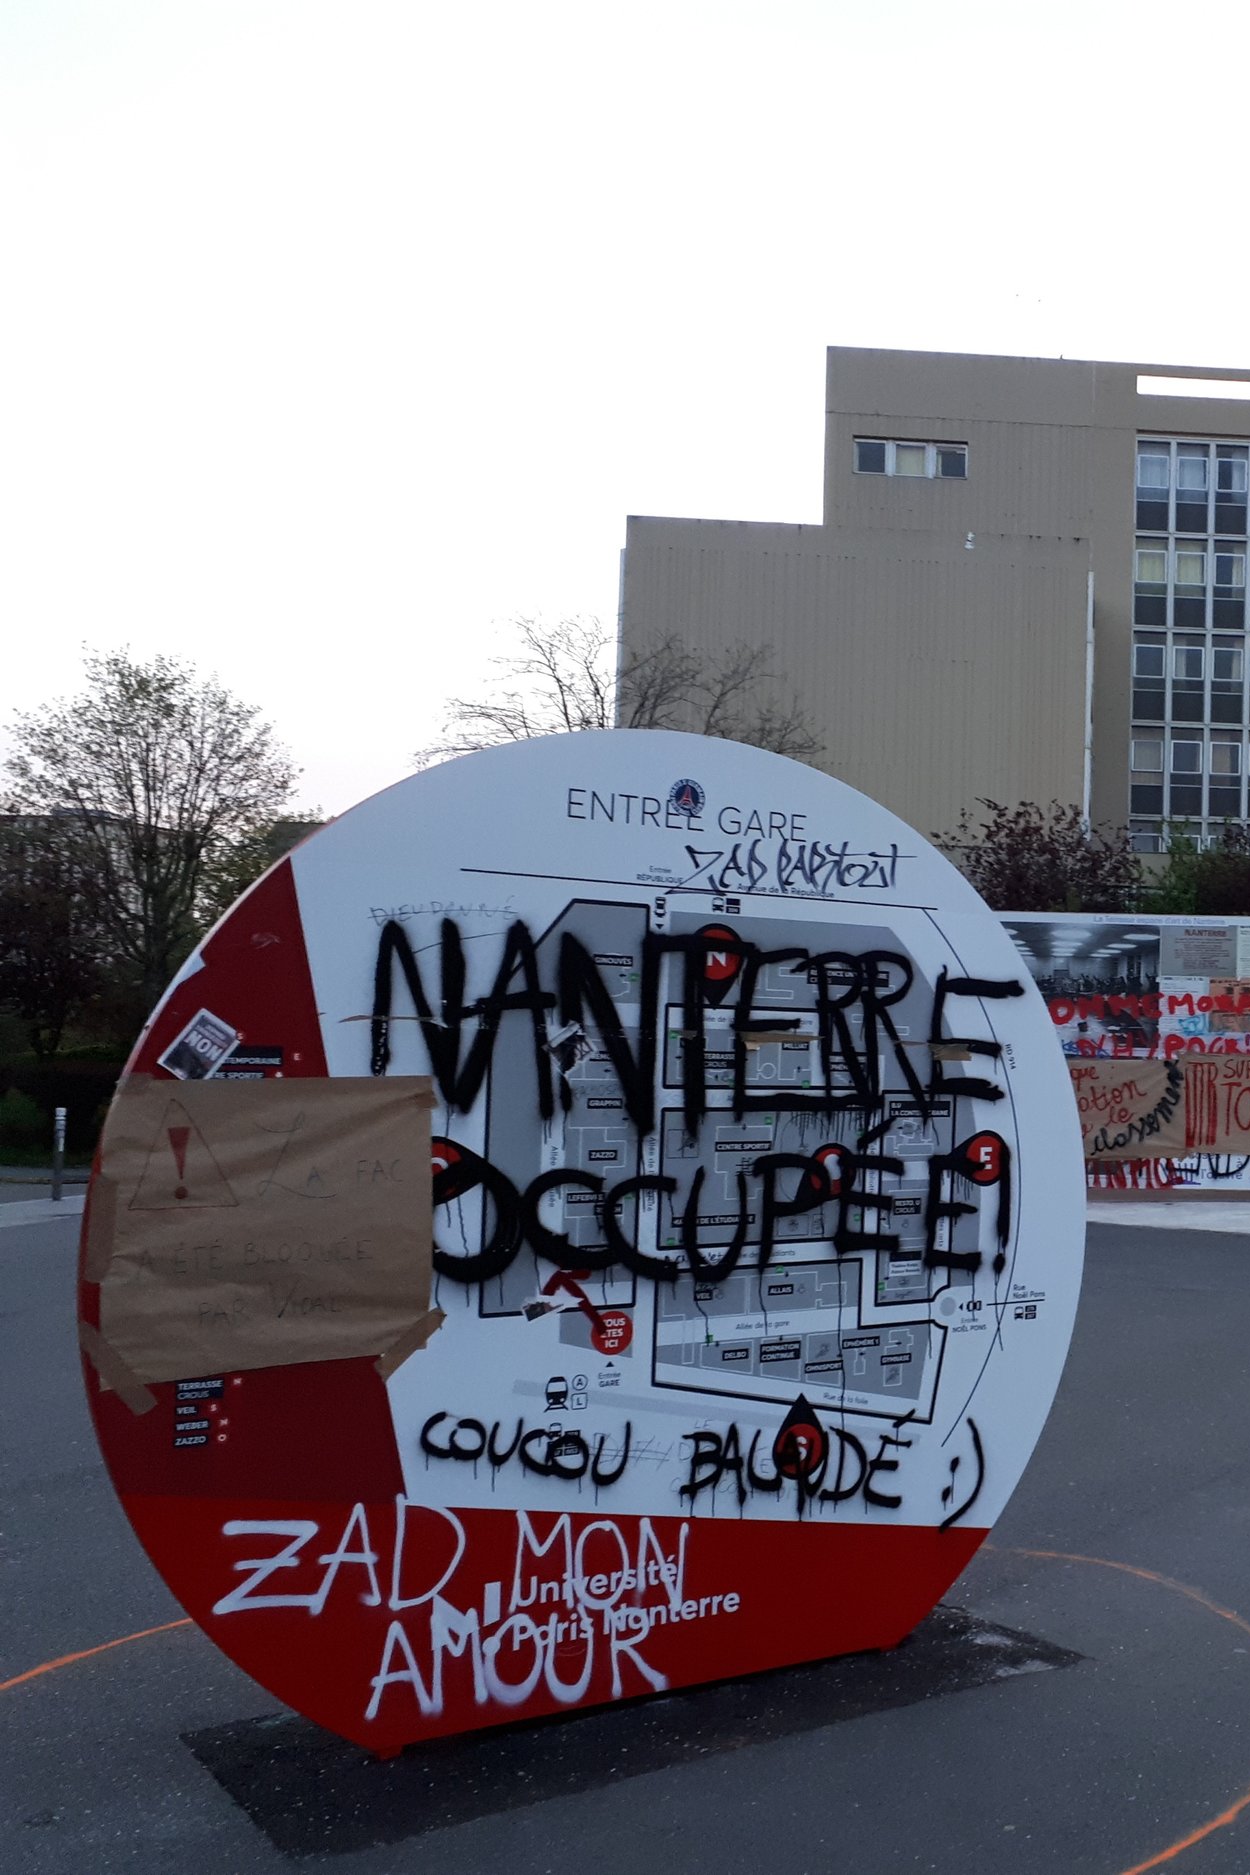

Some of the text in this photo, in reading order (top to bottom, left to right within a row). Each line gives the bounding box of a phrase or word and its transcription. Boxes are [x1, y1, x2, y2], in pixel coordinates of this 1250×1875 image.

[717, 805, 807, 843] GARE
[1184, 929, 1227, 938] NANTERRE
[706, 950, 727, 967] N
[371, 917, 1025, 1138] NANTERRE
[184, 1030, 225, 1062] NON
[980, 1146, 993, 1170] E
[355, 1159, 404, 1184] FAC
[604, 1339, 619, 1349] ICI
[177, 1390, 210, 1400] CROUS
[178, 1380, 224, 1391] TERRASSE
[598, 1379, 621, 1387] GARE
[176, 1406, 197, 1415] VEIL
[175, 1435, 207, 1446] ZAZZO
[420, 1411, 631, 1486] COUCOU
[212, 1493, 690, 1617] ZAD MON
[516, 1555, 679, 1610] Université
[364, 1603, 670, 1721] AMOUR
